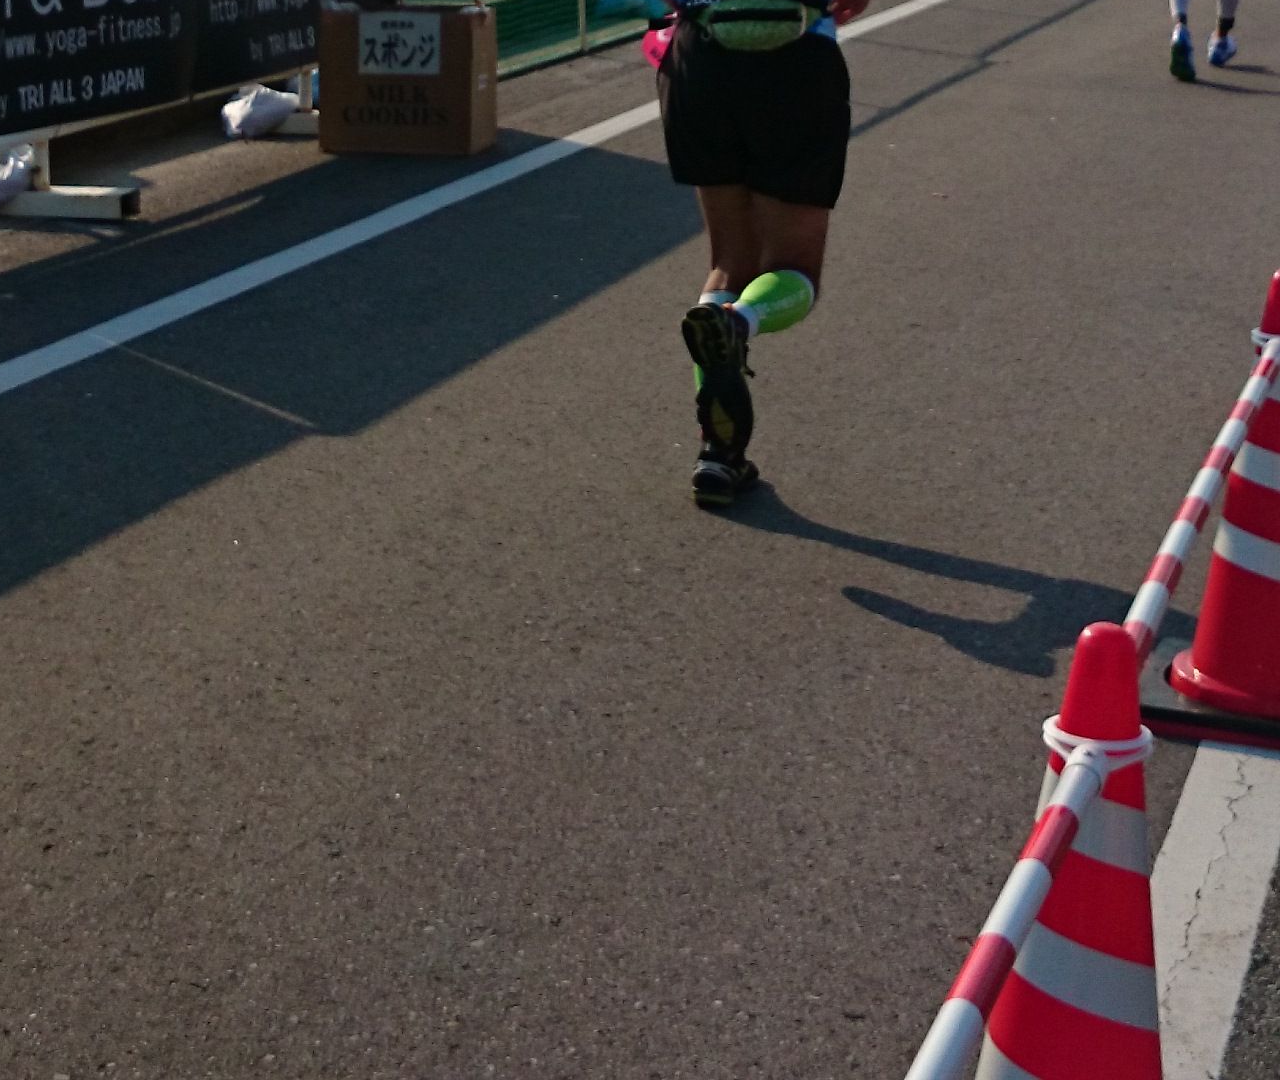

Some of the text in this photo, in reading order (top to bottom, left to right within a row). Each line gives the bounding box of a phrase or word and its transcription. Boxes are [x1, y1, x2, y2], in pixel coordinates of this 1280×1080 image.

[363, 32, 435, 68] スポンジ
[18, 83, 44, 111] TRI
[50, 79, 76, 106] ALL
[81, 75, 93, 101] 3
[100, 68, 145, 97] JAPAN
